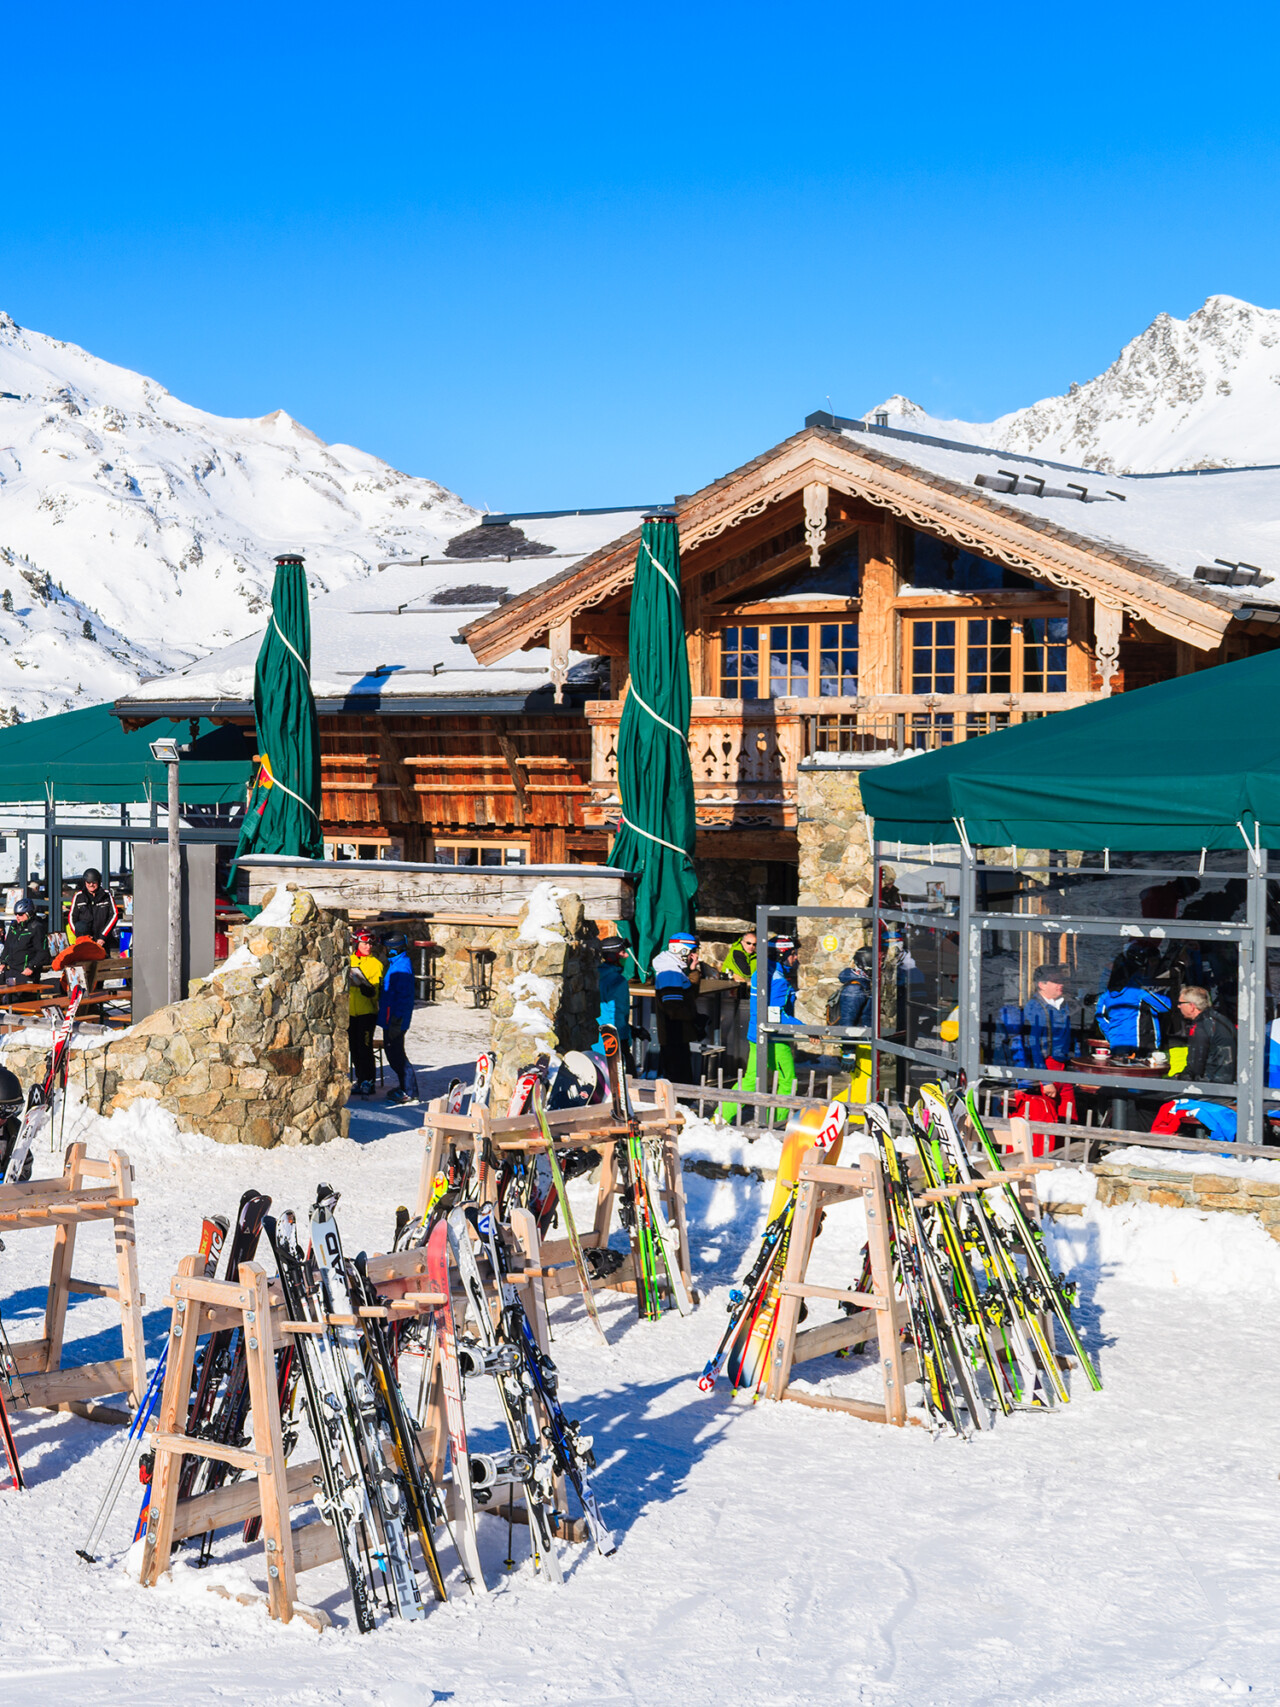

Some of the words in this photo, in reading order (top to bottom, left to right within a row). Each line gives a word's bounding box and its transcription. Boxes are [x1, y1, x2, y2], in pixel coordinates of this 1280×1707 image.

[616, 1060, 628, 1111] ROSSIGNOL
[814, 1123, 839, 1148] TO
[698, 1373, 716, 1392] GS
[384, 1520, 411, 1607] HEAD
[410, 1579, 422, 1603] SC
